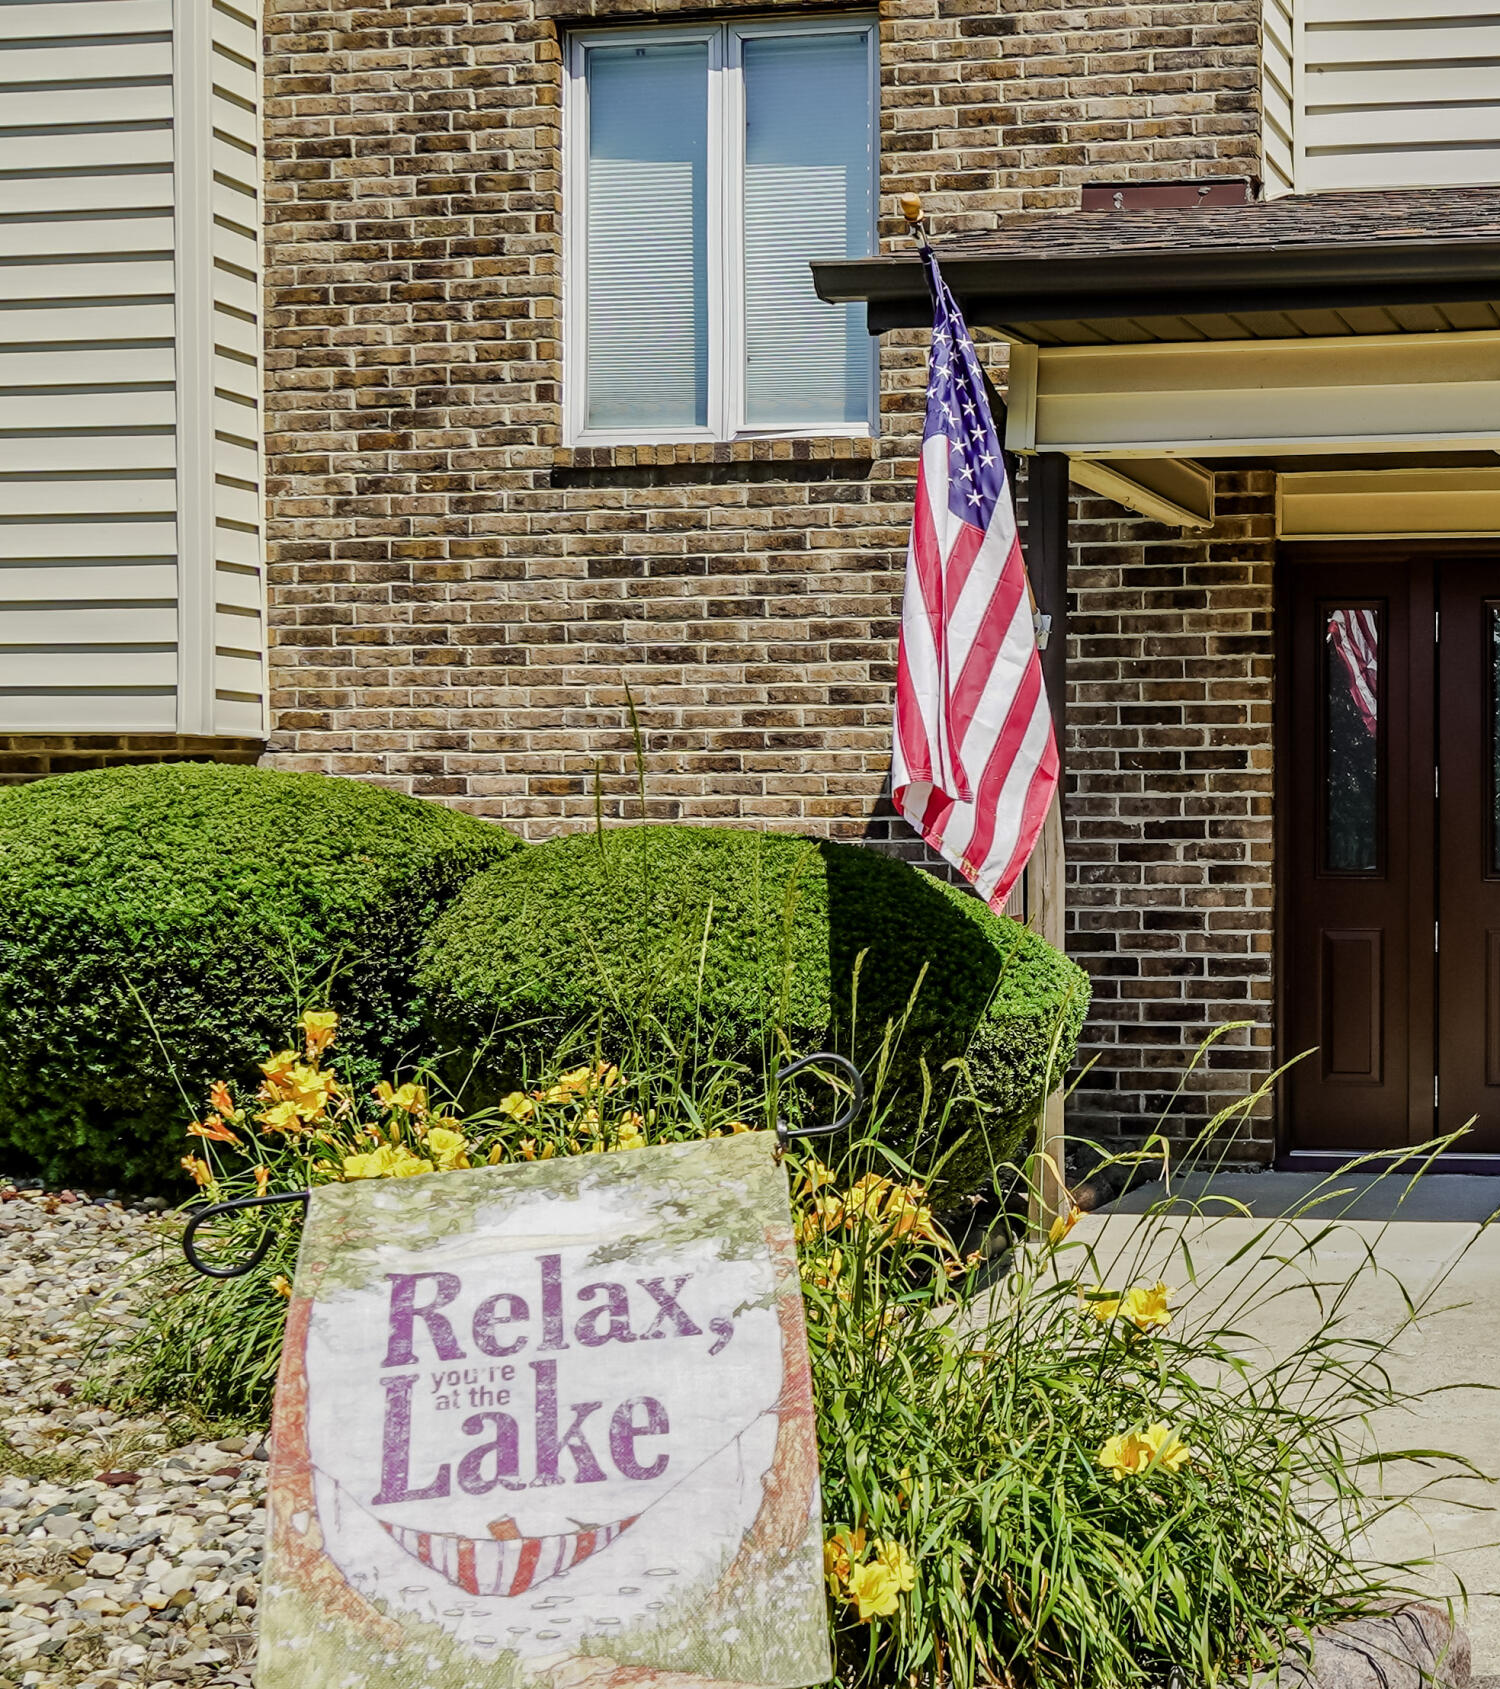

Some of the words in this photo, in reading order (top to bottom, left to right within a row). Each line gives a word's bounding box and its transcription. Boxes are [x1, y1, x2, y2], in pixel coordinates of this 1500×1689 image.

[381, 1254, 735, 1368] Relax,
[430, 1364, 515, 1394] you're
[435, 1389, 461, 1410] at
[468, 1385, 511, 1408] the
[371, 1359, 671, 1505] Lake
